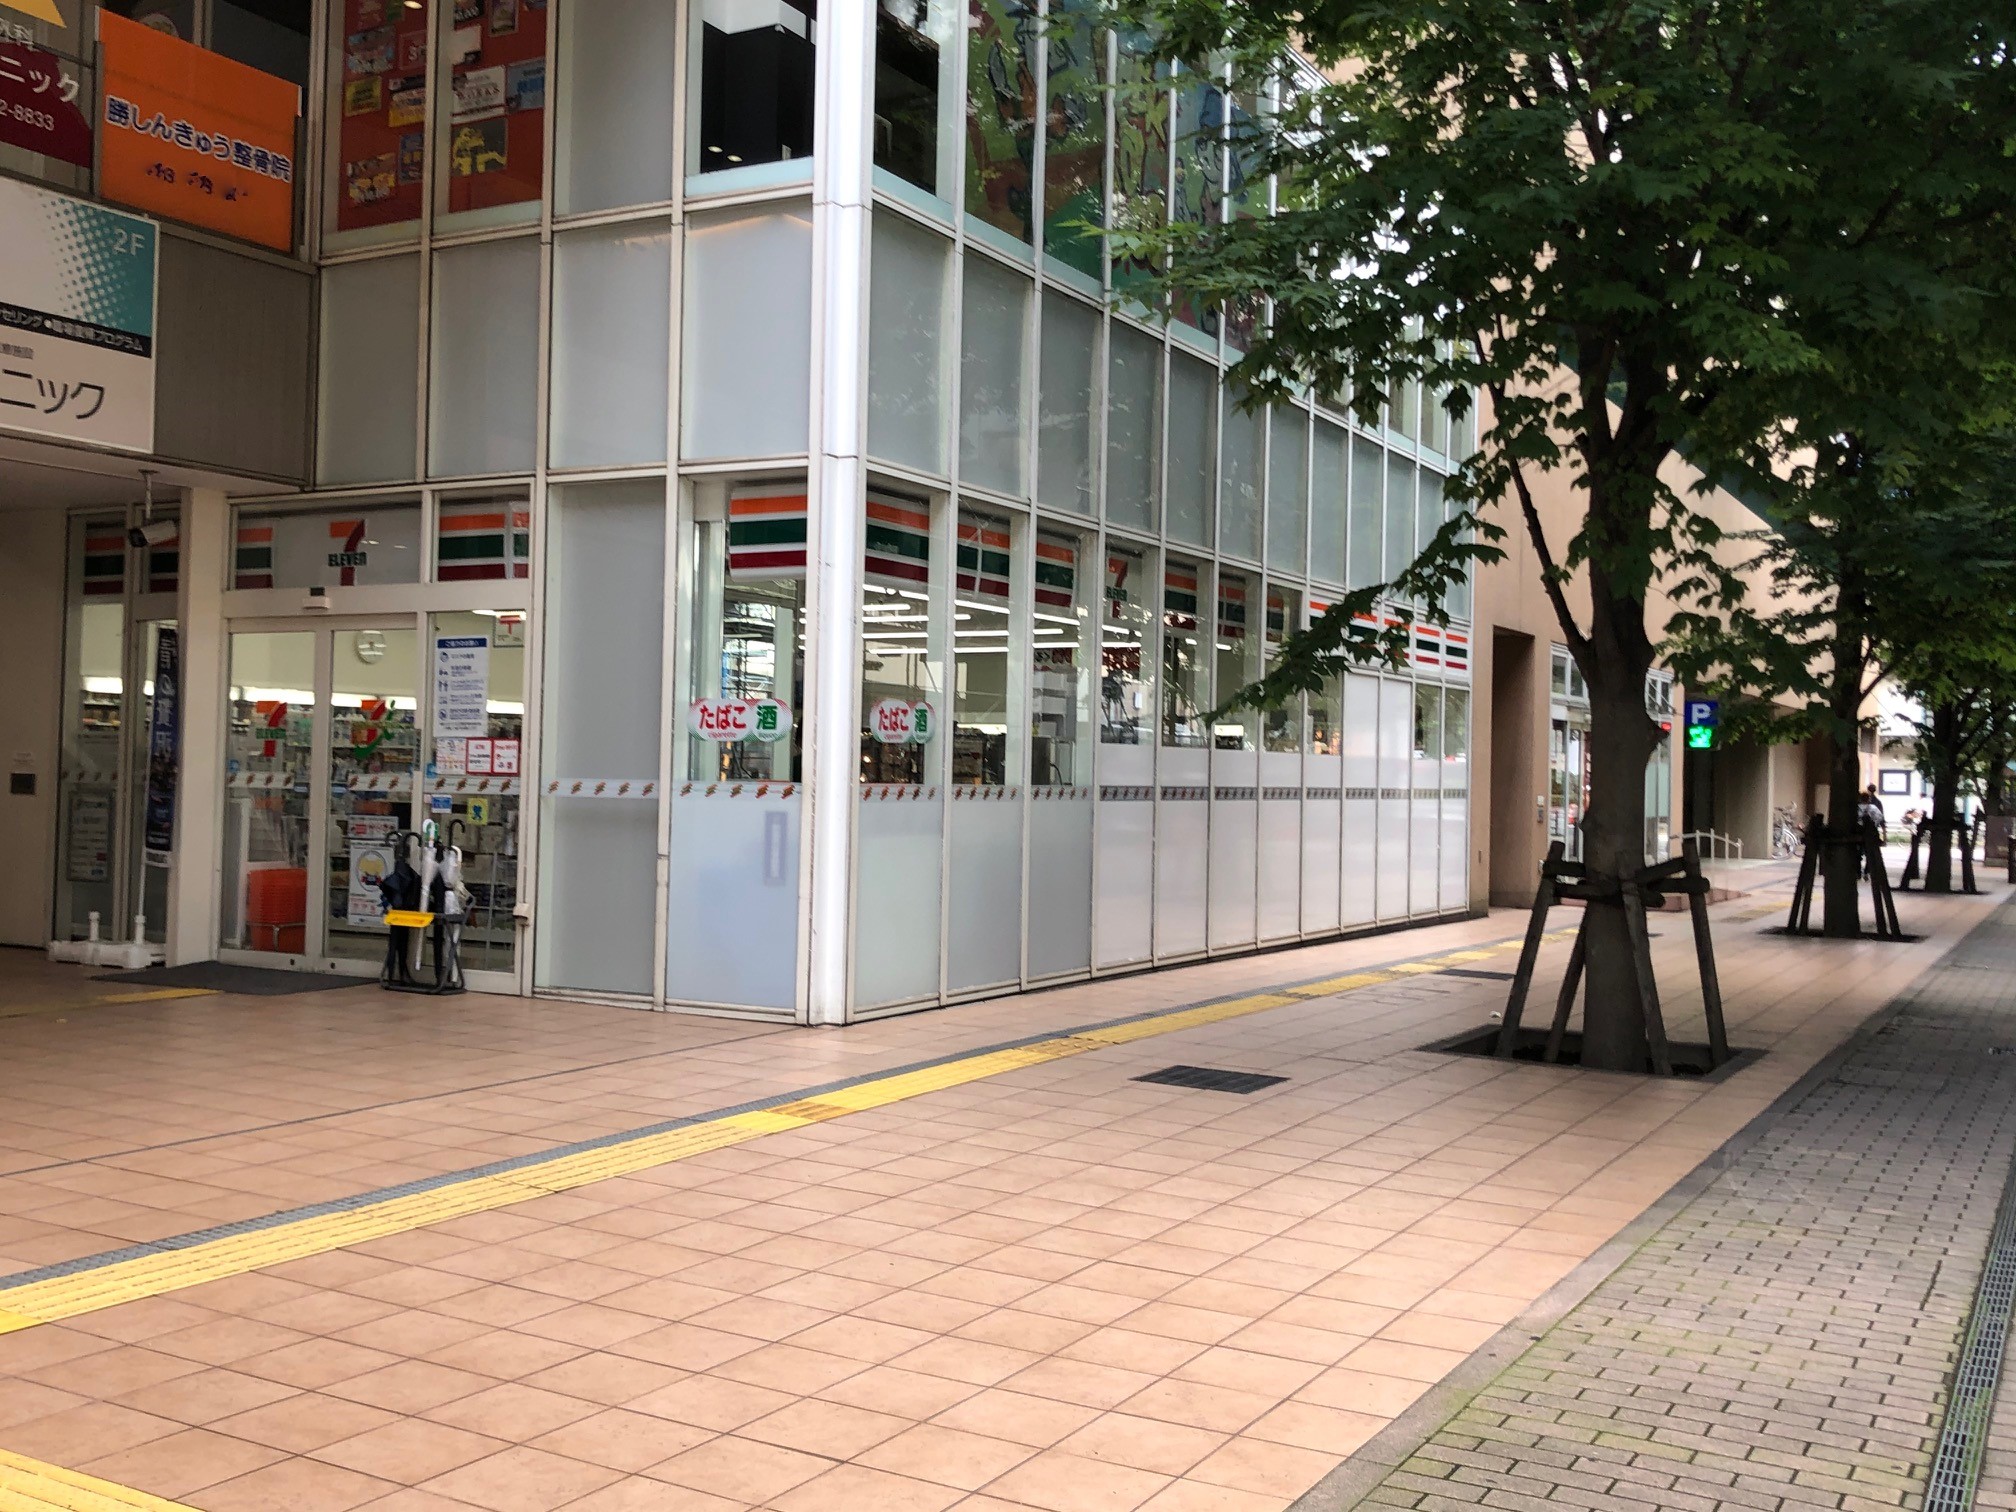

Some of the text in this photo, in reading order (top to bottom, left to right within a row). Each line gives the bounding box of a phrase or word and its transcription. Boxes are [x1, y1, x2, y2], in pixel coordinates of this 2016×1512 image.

[113, 228, 145, 256] 2F
[0, 368, 104, 419] ニック
[699, 704, 778, 731] たばこ 酒
[877, 706, 928, 733] たばこ 酒
[1691, 703, 1712, 724] P
